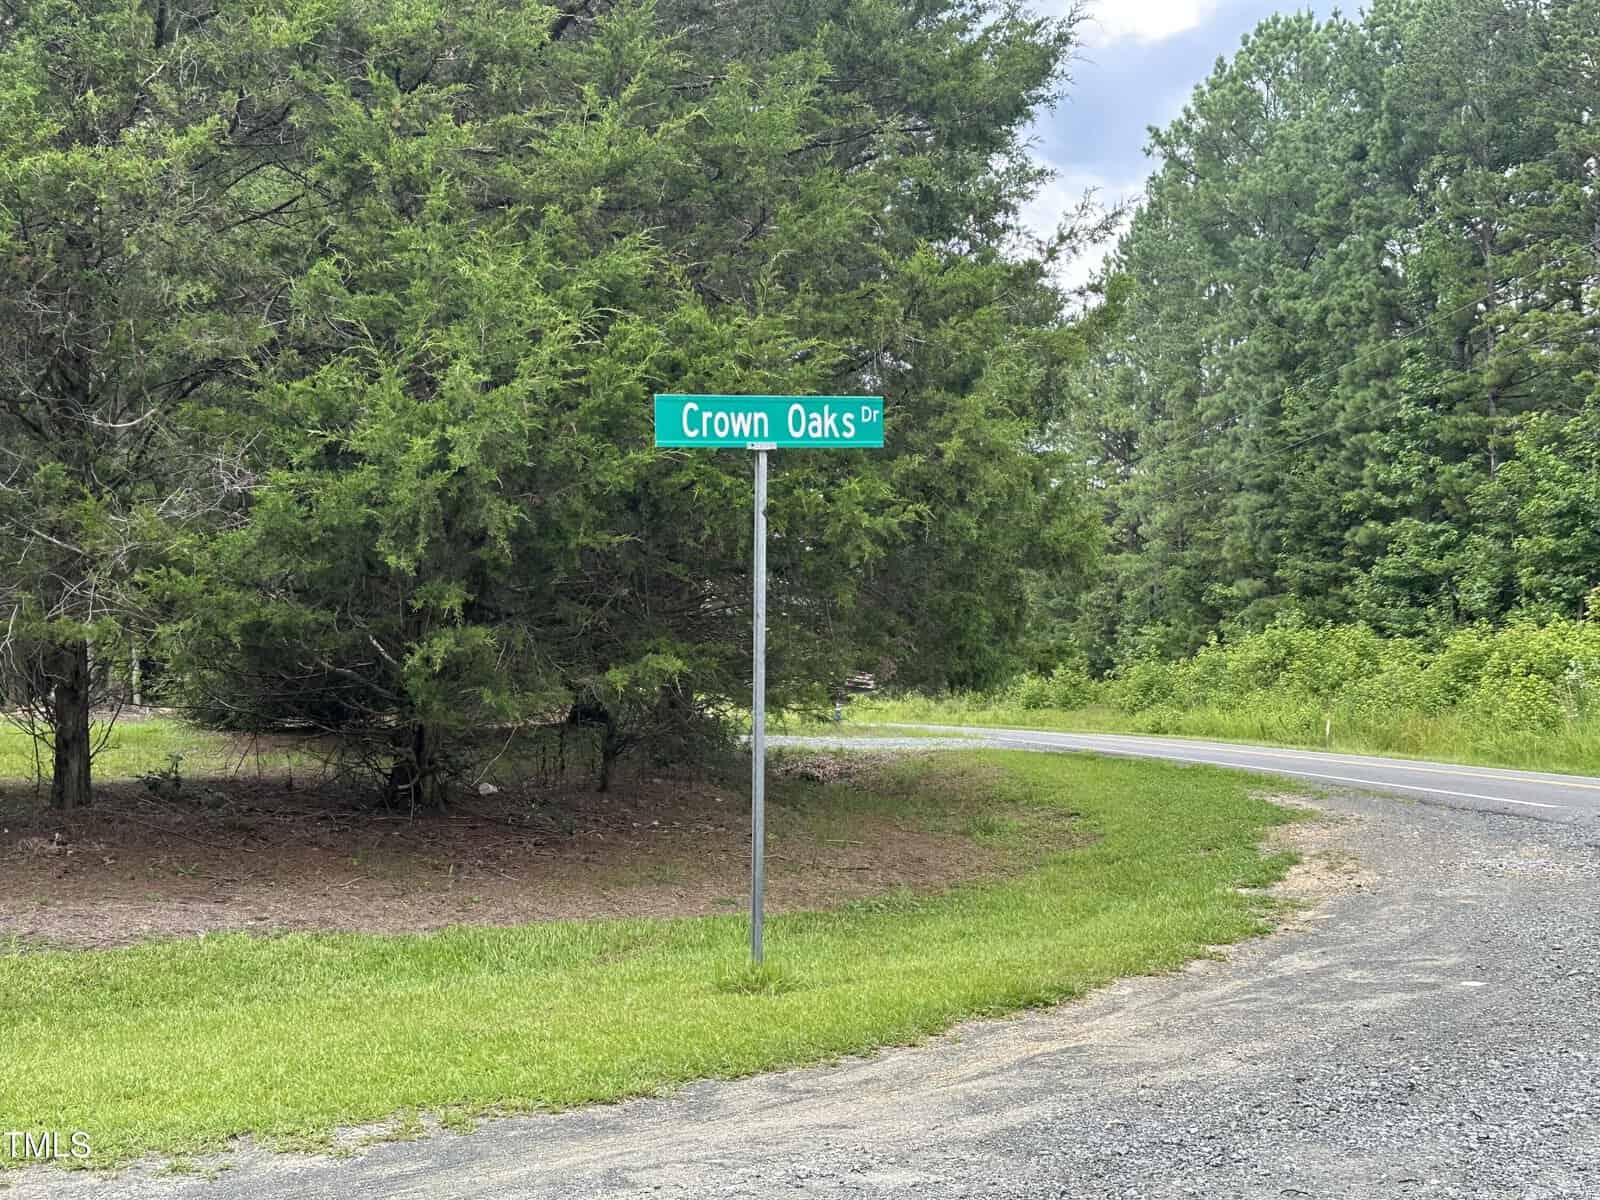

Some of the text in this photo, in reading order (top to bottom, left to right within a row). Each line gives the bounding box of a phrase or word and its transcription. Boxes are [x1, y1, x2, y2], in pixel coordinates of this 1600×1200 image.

[682, 402, 879, 438] Crown Oaks Dr
